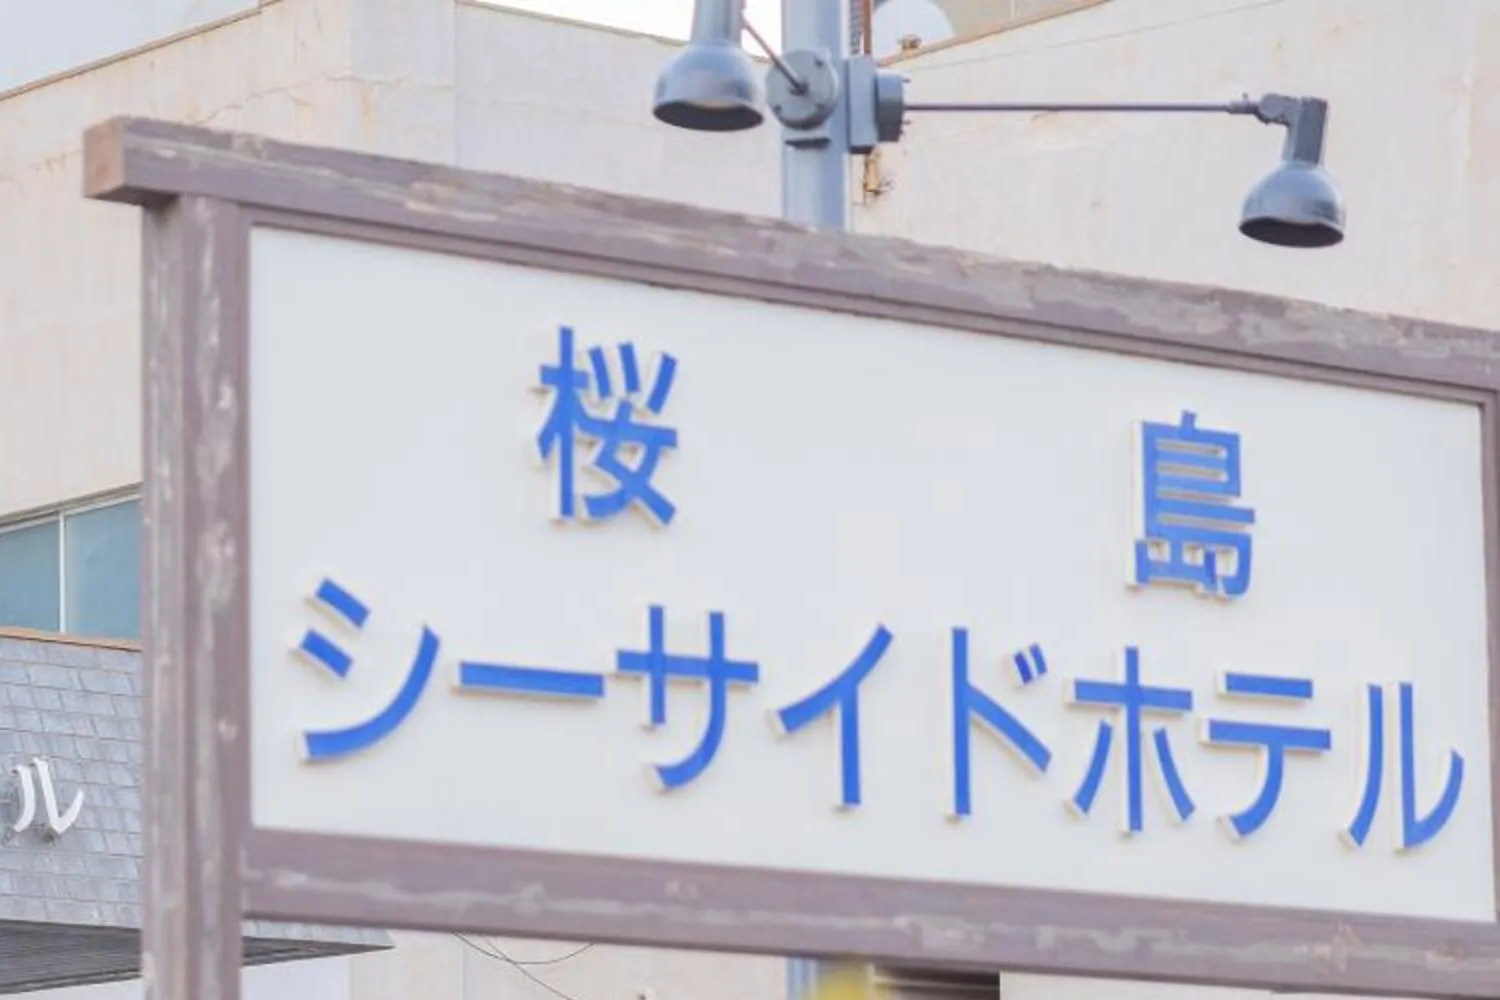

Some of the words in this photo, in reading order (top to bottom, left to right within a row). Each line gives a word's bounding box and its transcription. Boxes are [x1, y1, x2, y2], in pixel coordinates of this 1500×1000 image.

[299, 579, 1467, 850] シーサイドホテル
